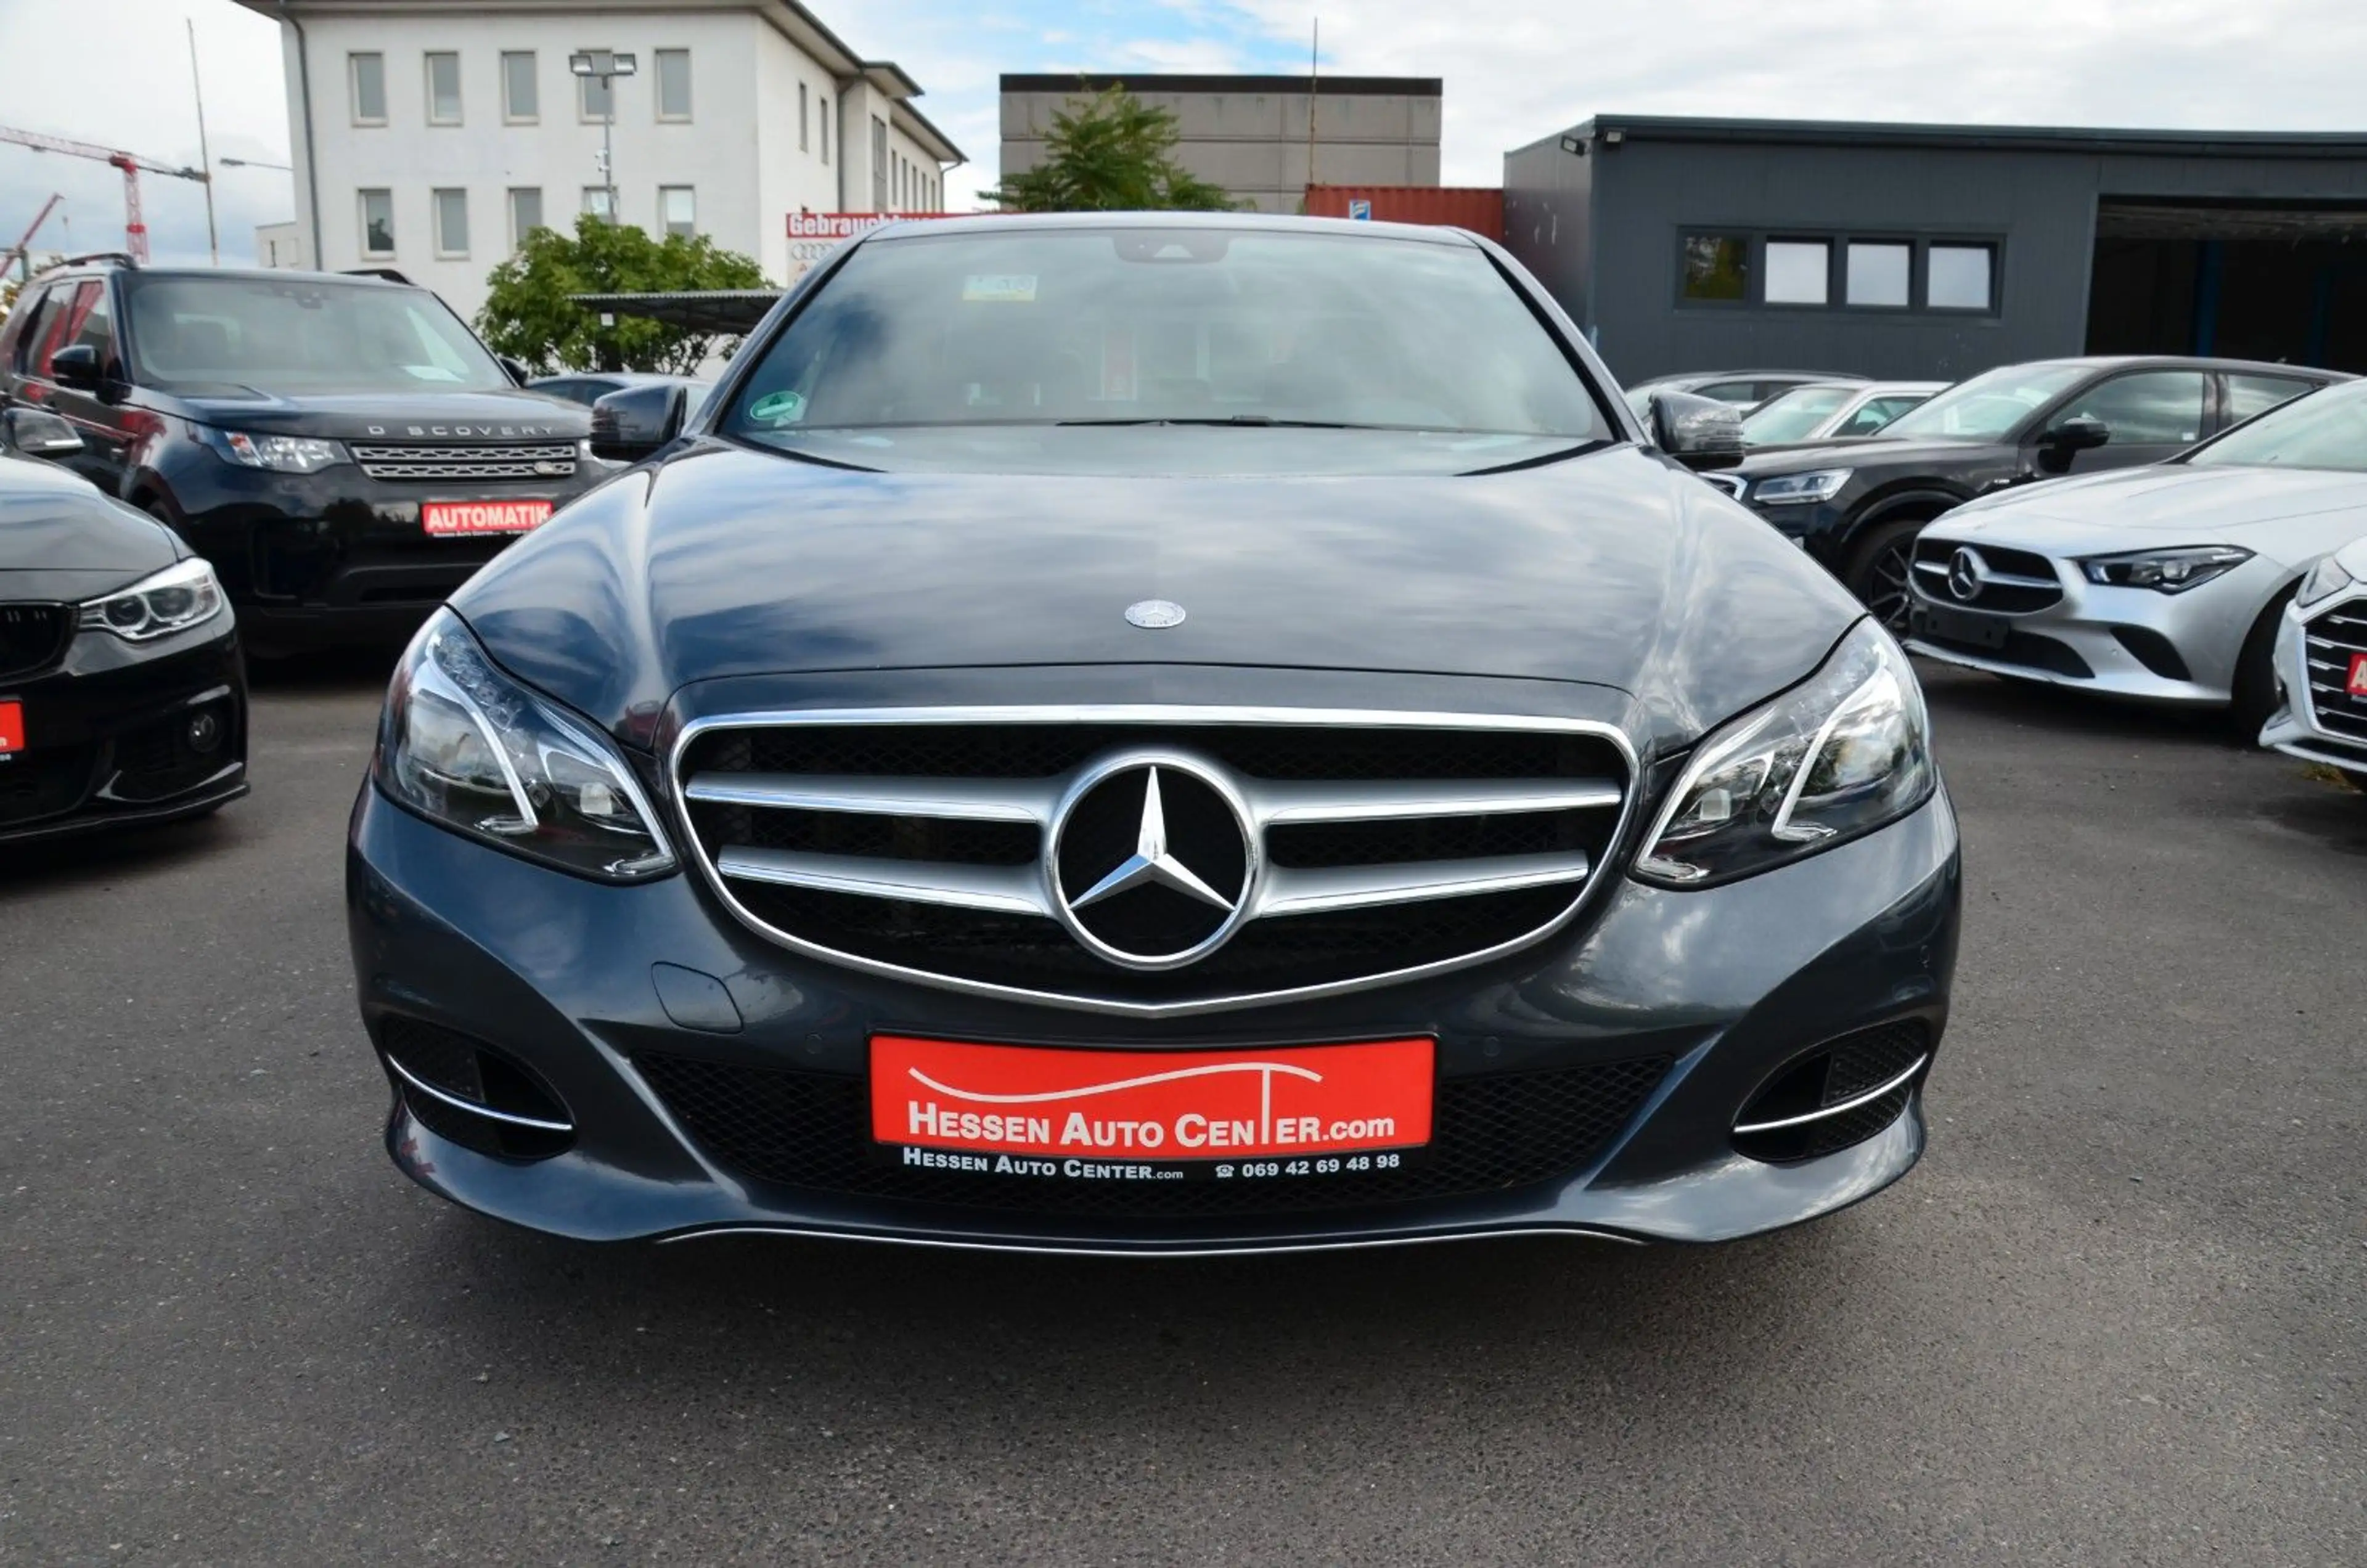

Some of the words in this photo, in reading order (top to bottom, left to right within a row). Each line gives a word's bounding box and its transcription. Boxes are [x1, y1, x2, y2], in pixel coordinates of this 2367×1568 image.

[368, 426, 553, 436] DSCOVERY
[428, 506, 549, 528] AUTOMATIK
[909, 1100, 1050, 1143] HESSEN
[1060, 1112, 1164, 1148] AUTO
[904, 1147, 987, 1171] HESSEN
[994, 1155, 1057, 1175] AUTO
[1242, 1162, 1279, 1177] 069
[1285, 1161, 1309, 1175] 42
[1316, 1159, 1339, 1173] 69
[1346, 1156, 1370, 1170] 48
[1376, 1154, 1399, 1169] 98
